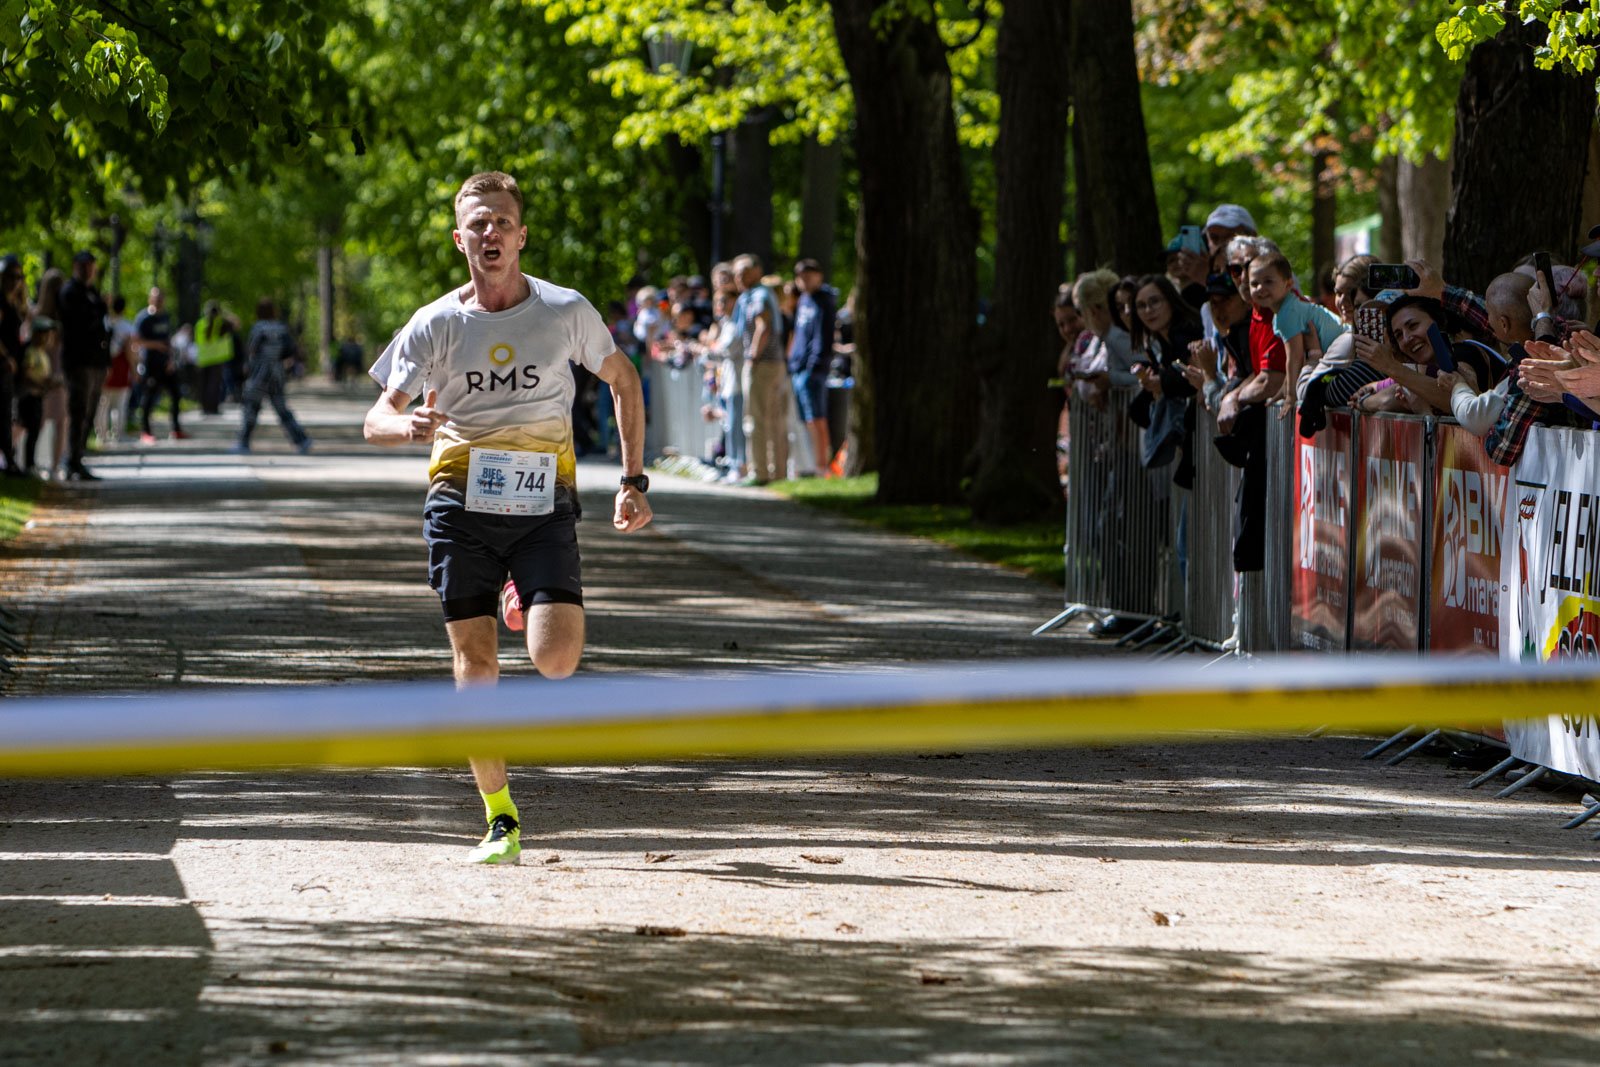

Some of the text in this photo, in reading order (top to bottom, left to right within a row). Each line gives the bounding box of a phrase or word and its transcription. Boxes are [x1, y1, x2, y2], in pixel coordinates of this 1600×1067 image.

[465, 364, 540, 395] RMS
[515, 471, 546, 492] 744
[1380, 457, 1416, 542] BIKE
[1465, 471, 1507, 557] BIK
[1381, 554, 1415, 599] maraton
[1467, 575, 1499, 617] mara
